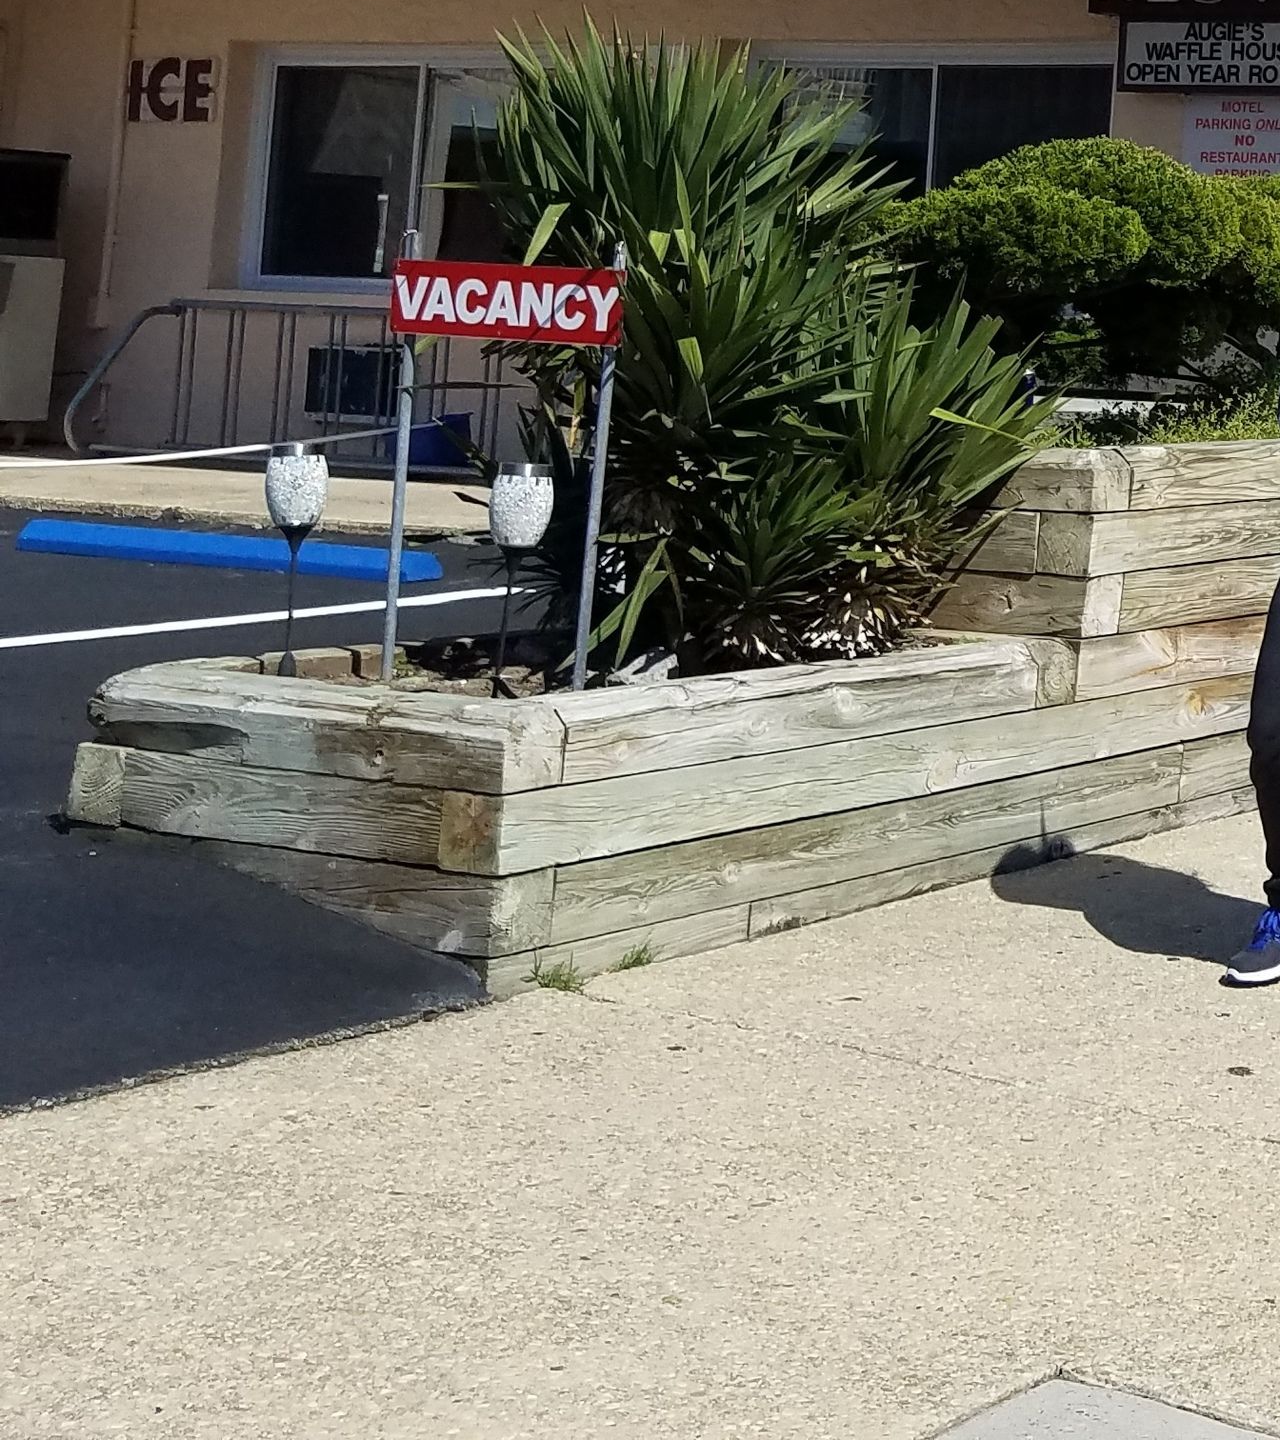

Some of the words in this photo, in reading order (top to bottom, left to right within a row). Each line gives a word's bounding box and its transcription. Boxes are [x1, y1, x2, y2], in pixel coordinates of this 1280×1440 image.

[1184, 22, 1264, 42] AUGIE'S
[1146, 42, 1222, 61] WAFFLE
[1126, 62, 1180, 83] OPEN
[1187, 63, 1241, 83] YEAR
[128, 57, 212, 122] ICE
[1221, 101, 1264, 113] MOTEL
[1195, 117, 1251, 130] PARKING
[1234, 135, 1255, 146] NO
[394, 274, 620, 332] VACANCY
